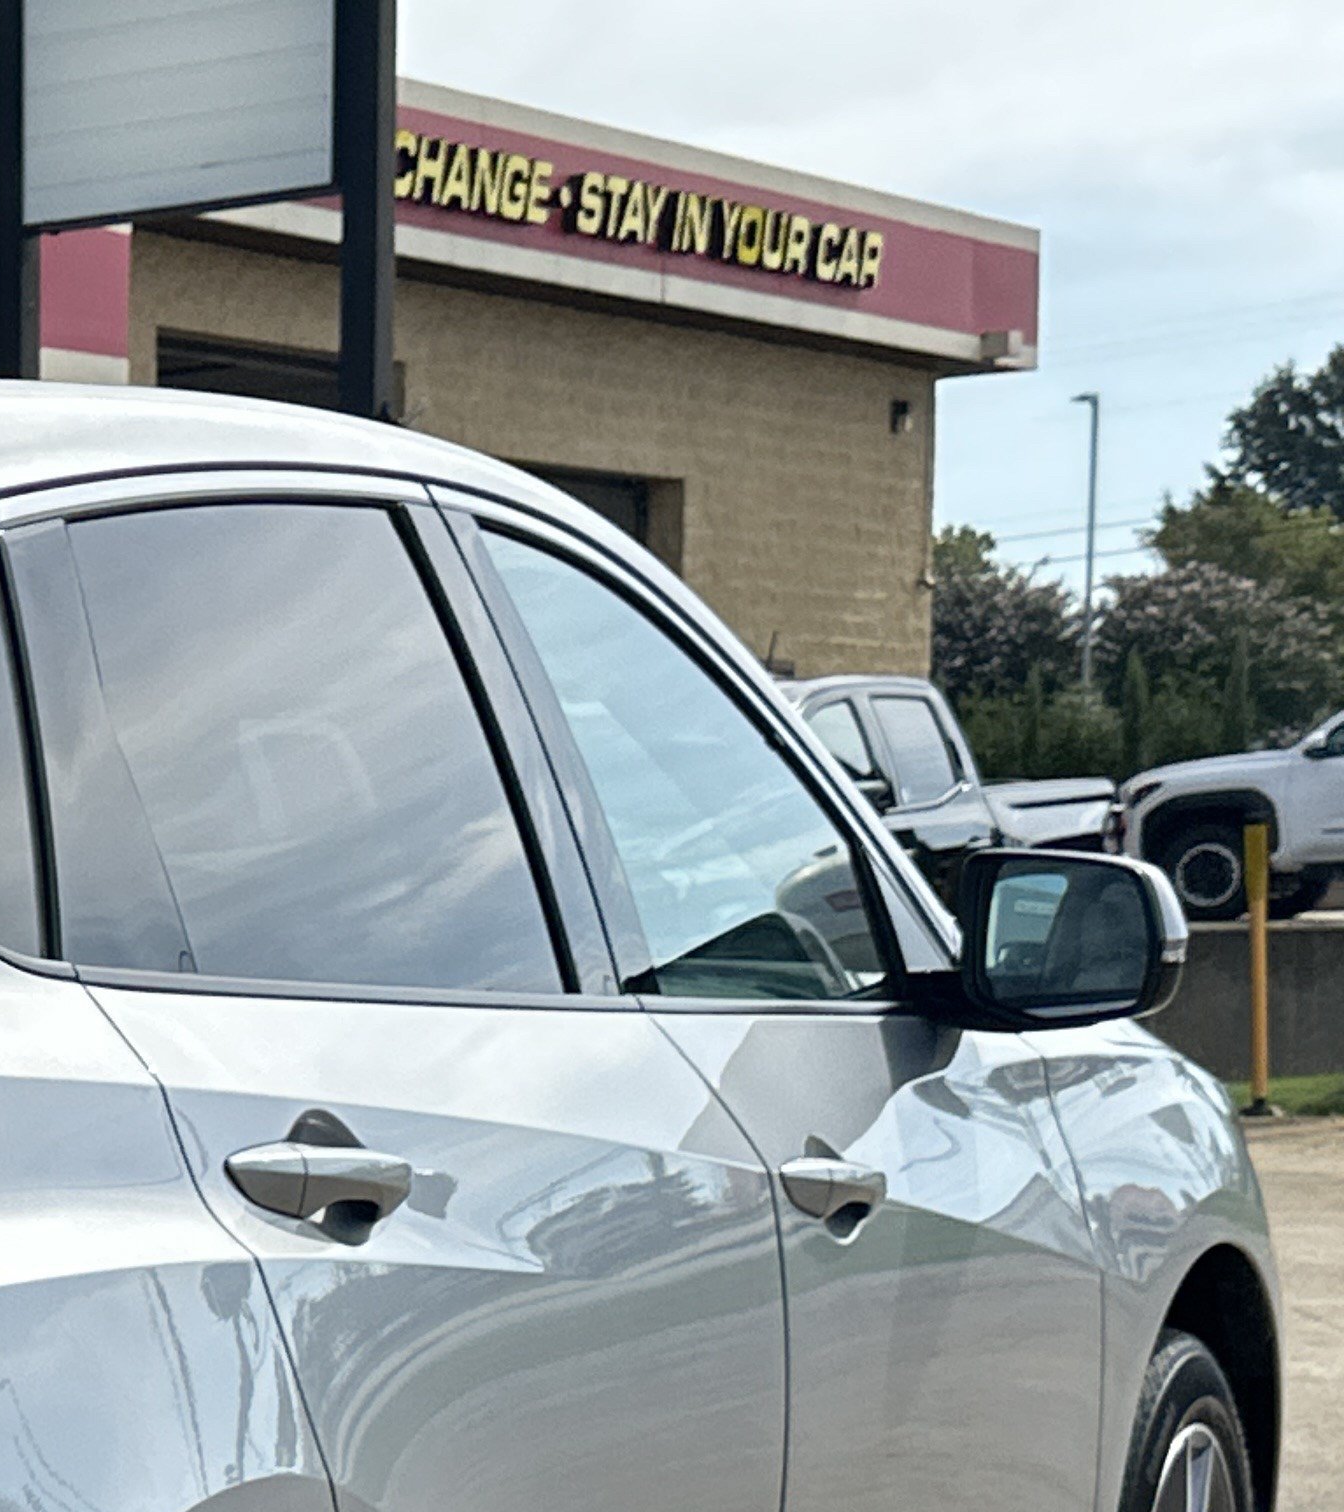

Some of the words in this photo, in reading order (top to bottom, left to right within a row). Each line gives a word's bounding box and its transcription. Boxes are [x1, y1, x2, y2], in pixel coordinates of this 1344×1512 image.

[395, 129, 554, 224] CHANGE
[576, 171, 667, 245] STAY
[671, 191, 711, 254] IN
[722, 200, 811, 276] YOUR
[816, 223, 883, 289] CAR
